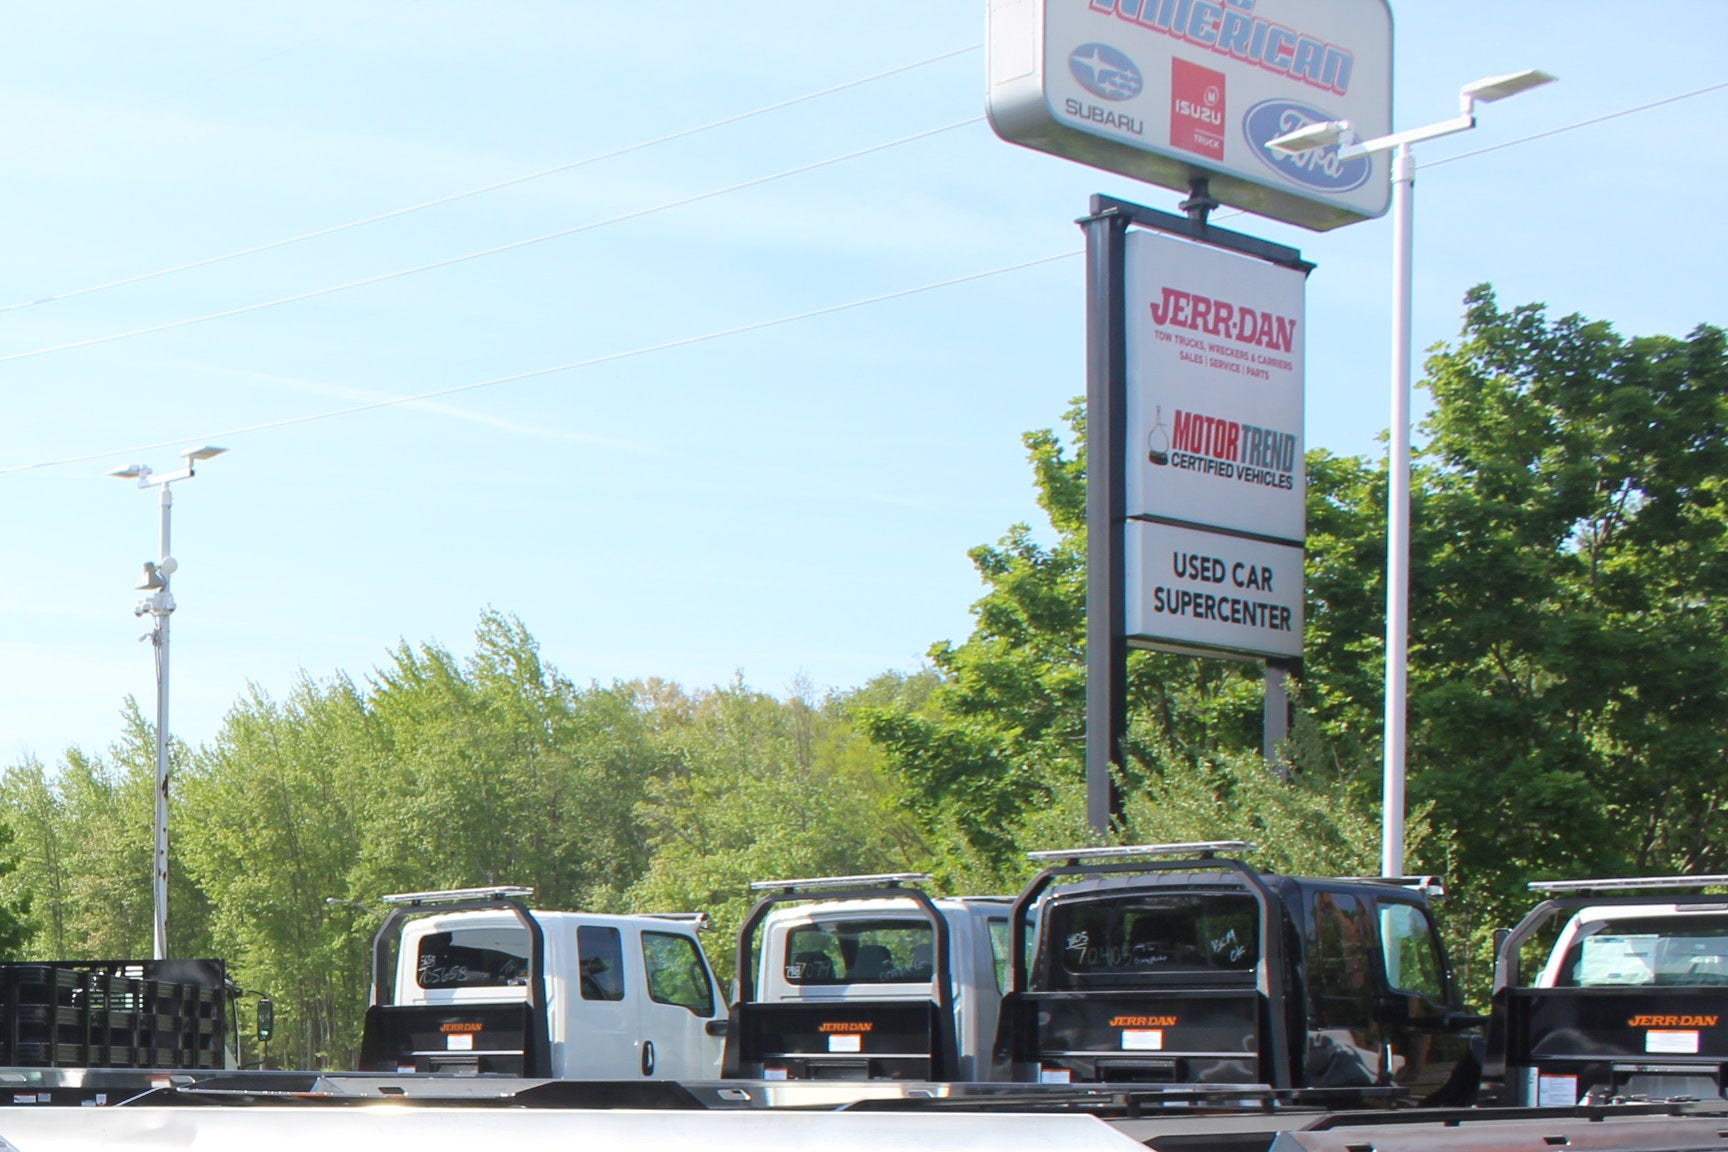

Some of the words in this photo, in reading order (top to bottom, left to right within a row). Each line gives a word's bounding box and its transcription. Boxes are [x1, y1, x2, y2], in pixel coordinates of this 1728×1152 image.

[1088, 0, 1354, 95] MERICAN
[1065, 98, 1144, 135] SUBARU
[1175, 98, 1222, 125] ISUZU
[1193, 133, 1221, 149] TRUCK
[1154, 330, 1172, 343] TOW
[1174, 334, 1206, 350] TRUCKS,
[1207, 343, 1250, 362] WRECKERS
[1257, 354, 1293, 371] CARRIERS
[1179, 351, 1204, 365] SALES
[1209, 357, 1241, 374] SERVICE
[1245, 366, 1270, 380] PARTS
[1171, 452, 1234, 478] CERTIFIED
[1236, 465, 1293, 490] VEHICLES
[1173, 551, 1226, 584] USED
[1232, 561, 1273, 592] CAR
[1153, 586, 1292, 632] SUPERCENTER
